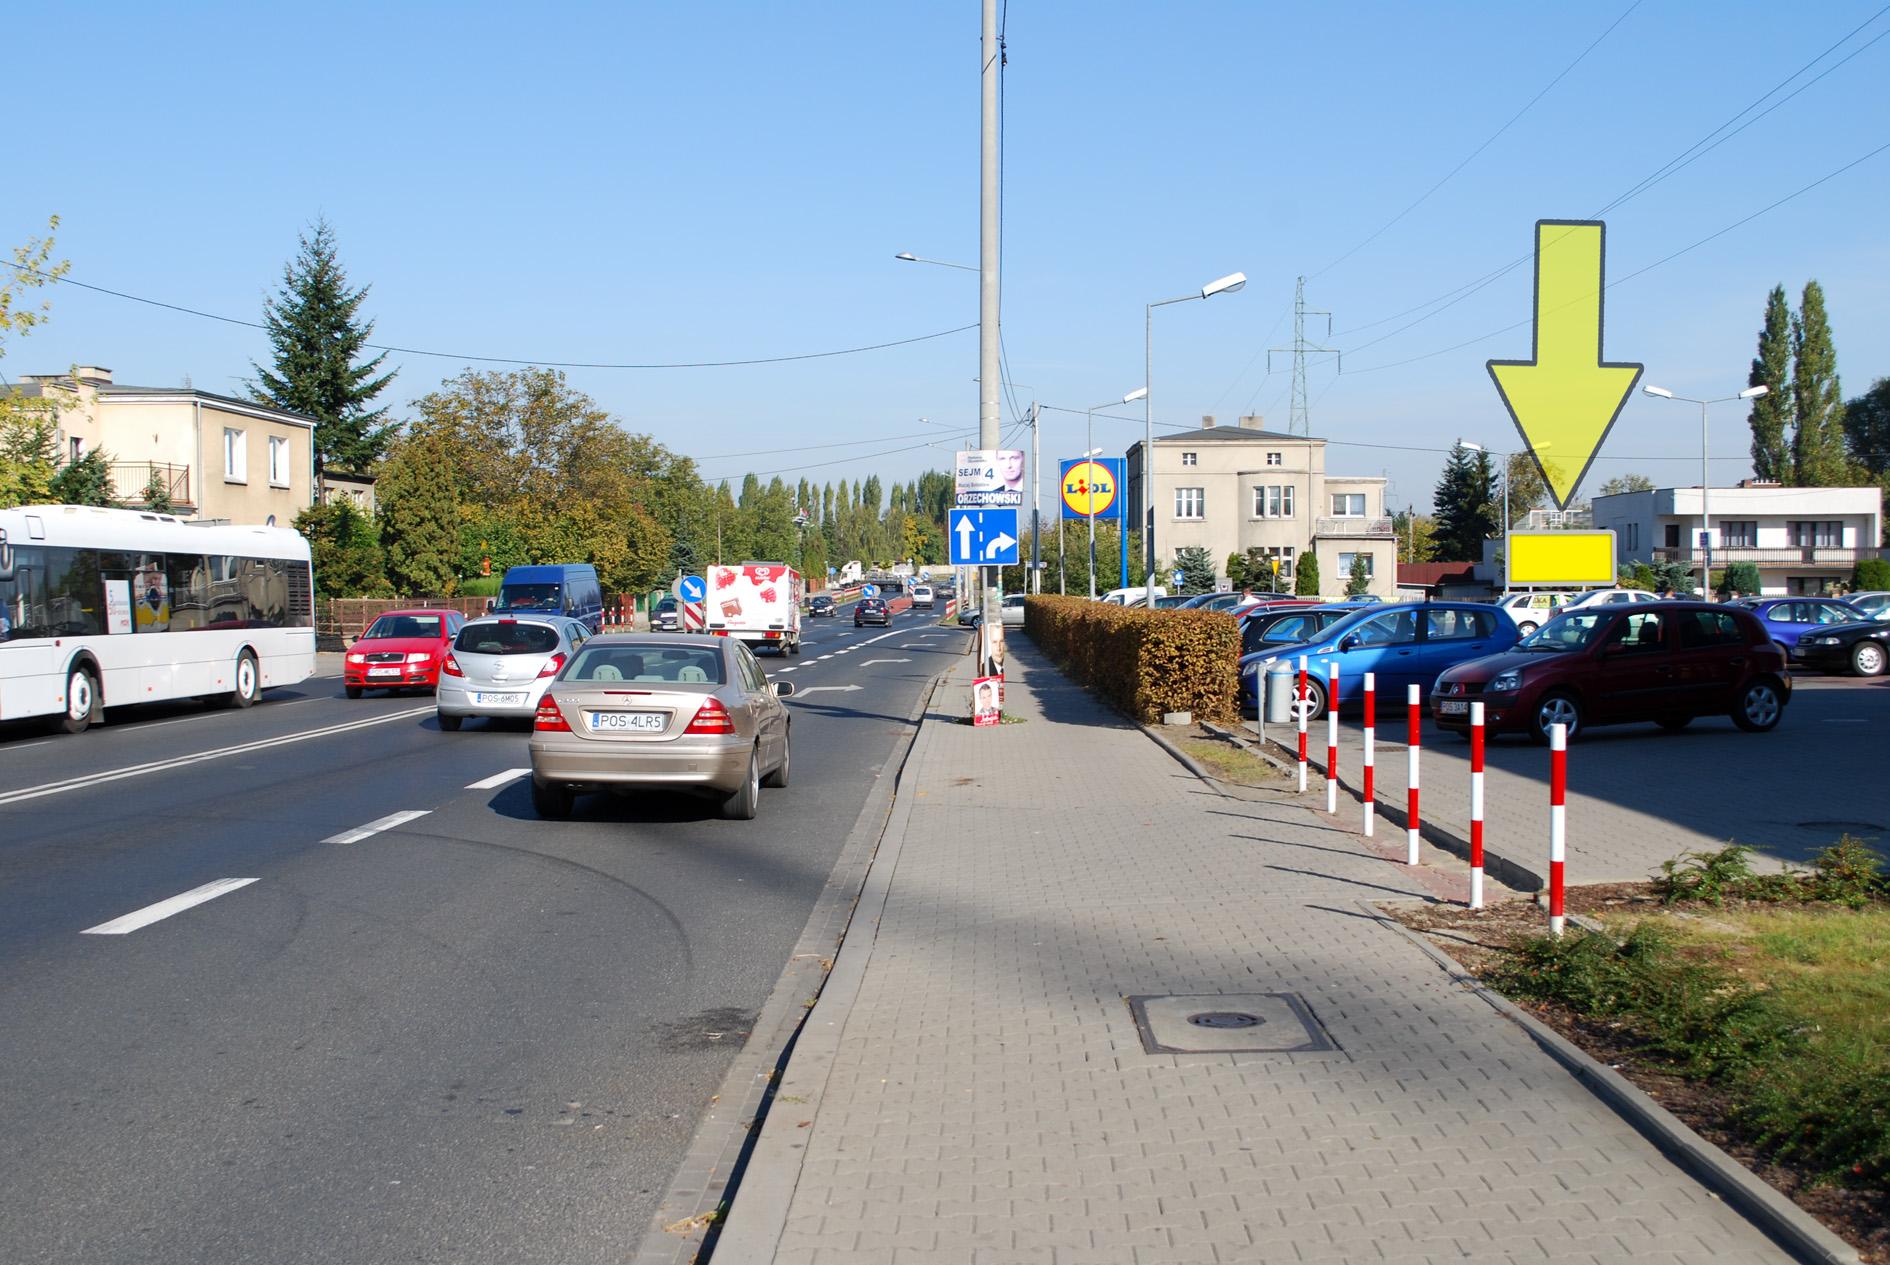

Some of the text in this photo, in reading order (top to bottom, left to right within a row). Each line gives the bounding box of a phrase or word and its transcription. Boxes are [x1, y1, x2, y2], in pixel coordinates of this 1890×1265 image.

[958, 467, 994, 479] SEJM 4
[958, 493, 1021, 504] ORZECHOWSKI
[482, 694, 498, 702] POS
[600, 715, 661, 728] POS 4LR5
